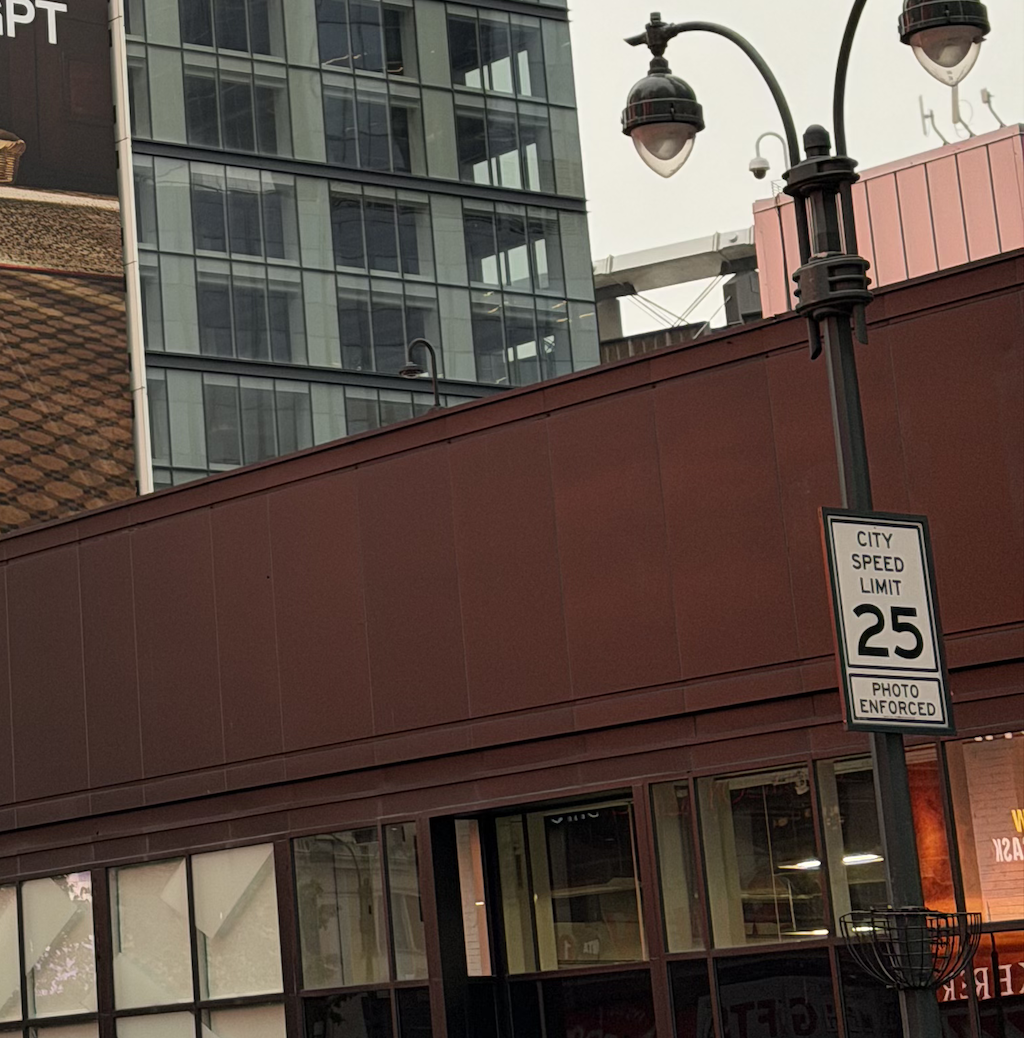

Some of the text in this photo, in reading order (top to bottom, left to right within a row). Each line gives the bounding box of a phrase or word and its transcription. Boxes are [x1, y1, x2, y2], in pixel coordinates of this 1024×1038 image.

[856, 530, 893, 549] CITY
[851, 553, 904, 573] SPEED
[860, 577, 902, 596] LIMIT
[852, 603, 924, 660] 25
[872, 682, 919, 699] PHOTO
[860, 699, 936, 717] ENFORCED
